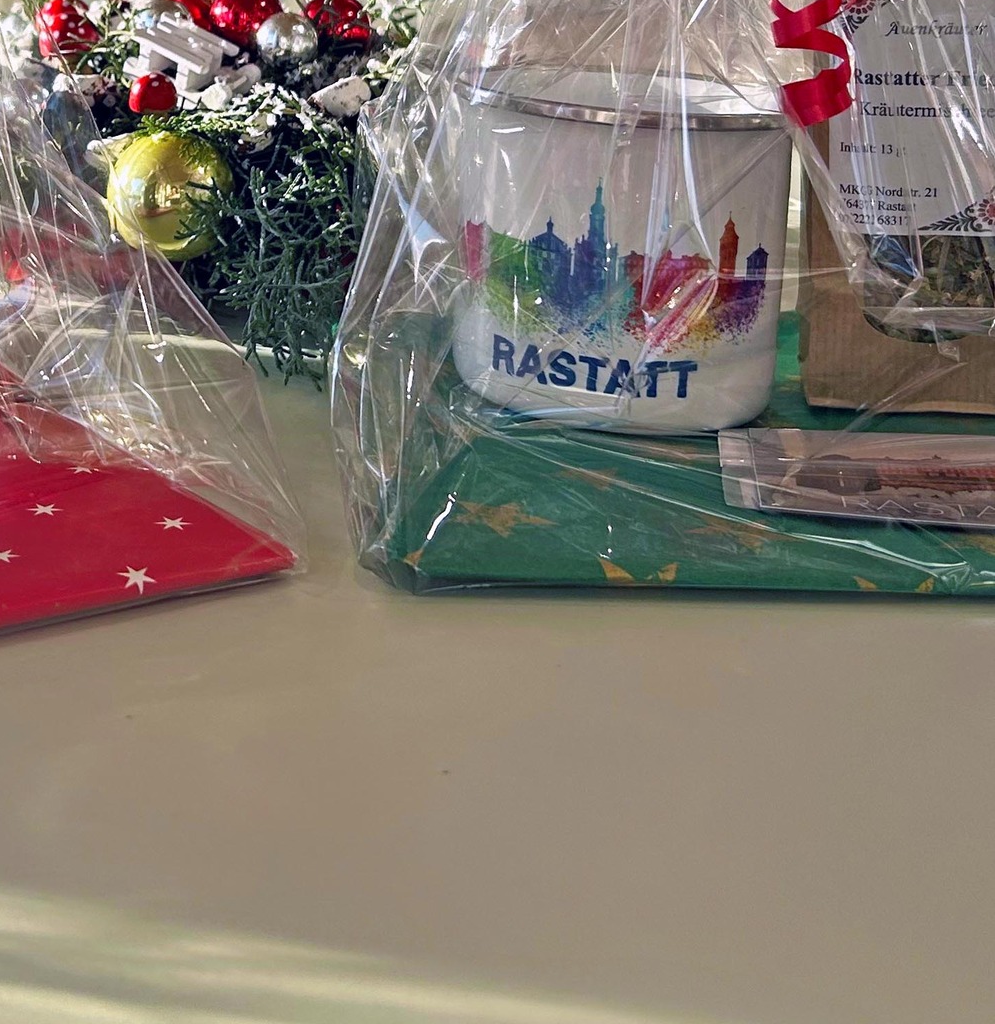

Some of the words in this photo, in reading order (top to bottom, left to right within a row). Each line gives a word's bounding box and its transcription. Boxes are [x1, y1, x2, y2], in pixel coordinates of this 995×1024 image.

[881, 144, 893, 155] 13
[876, 185, 921, 197] Nordtr.
[924, 187, 938, 198] 21
[877, 200, 916, 212] Rastat
[492, 333, 698, 399] RASTATT
